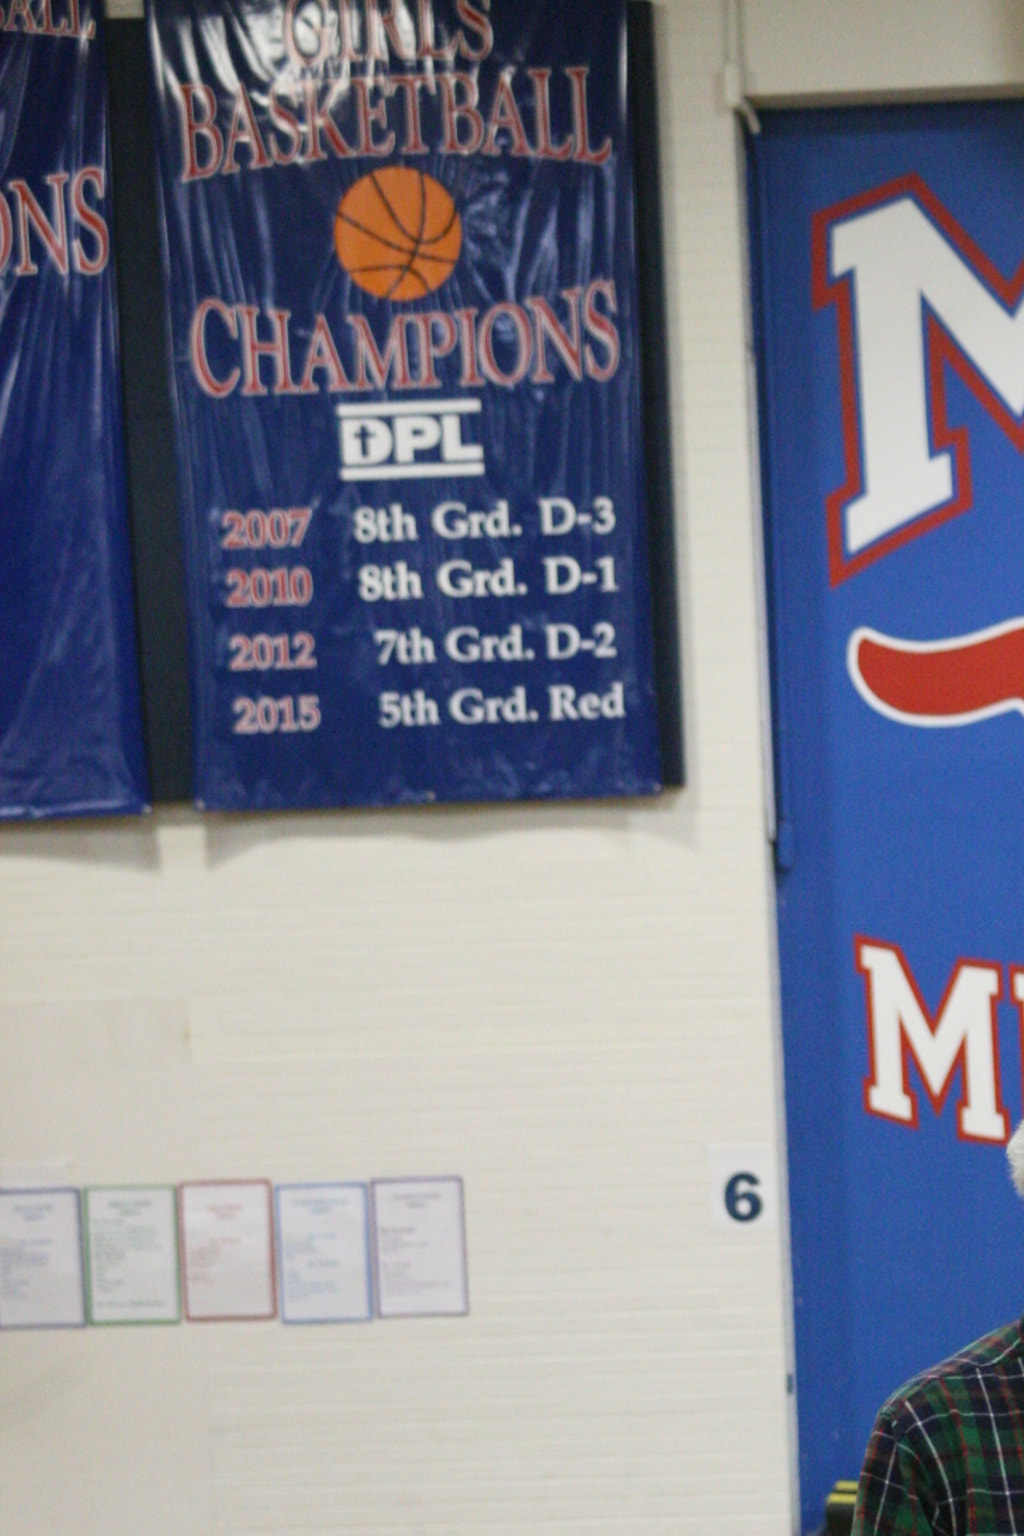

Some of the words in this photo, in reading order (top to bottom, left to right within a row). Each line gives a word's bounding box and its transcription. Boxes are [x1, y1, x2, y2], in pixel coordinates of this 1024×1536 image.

[180, 66, 612, 182] BASKETBALL
[189, 280, 620, 398] CHAMPIONS
[341, 413, 485, 466] DPL
[222, 507, 313, 549] 2007
[354, 504, 418, 544] 8th
[431, 500, 523, 539] Grd.
[538, 496, 616, 536] D-3
[226, 566, 313, 607] 2010
[358, 561, 423, 601] 8th
[436, 558, 527, 597] Grd.
[544, 555, 619, 595] D-1
[228, 631, 317, 671] 2012
[374, 627, 436, 666] 7th
[445, 624, 535, 663] Grd.
[545, 621, 617, 660] D-2
[232, 694, 321, 734] 2015
[378, 689, 439, 728] 5th
[449, 686, 539, 725] Grd.
[549, 682, 626, 721] Red
[724, 1173, 763, 1222] 6
